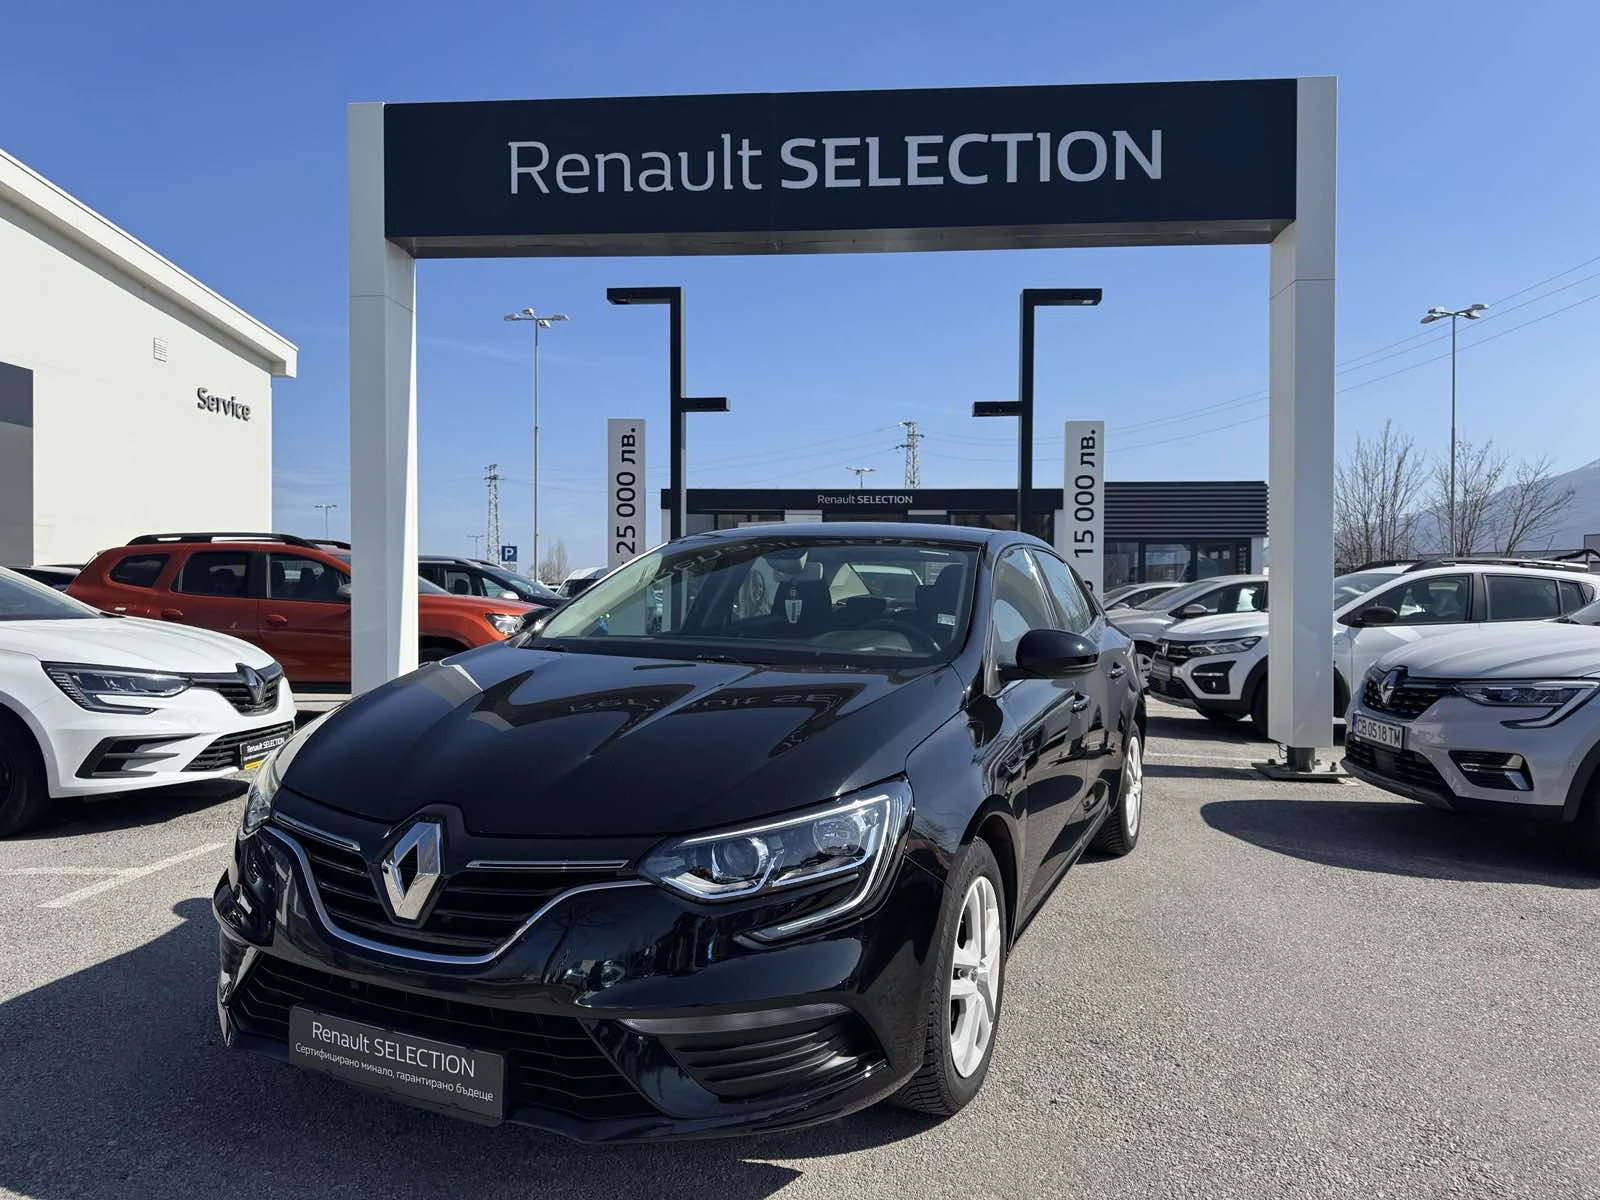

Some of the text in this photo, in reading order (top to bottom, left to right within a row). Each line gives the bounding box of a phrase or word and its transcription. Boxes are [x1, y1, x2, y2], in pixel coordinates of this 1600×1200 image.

[508, 129, 1162, 194] Renault SELECTION
[197, 387, 251, 421] Service
[1080, 429, 1097, 468] лв.
[616, 427, 636, 554] 25 000 лв.
[817, 494, 913, 504] Renault SELECTION
[1074, 474, 1096, 522] 000
[505, 547, 514, 561] P
[1074, 529, 1095, 559] 15
[246, 737, 285, 753] Renault SELECTION
[311, 1021, 476, 1078] Renault SELECTION
[295, 1042, 494, 1101] Сертифицирано минало, гарантирано бъдеще
